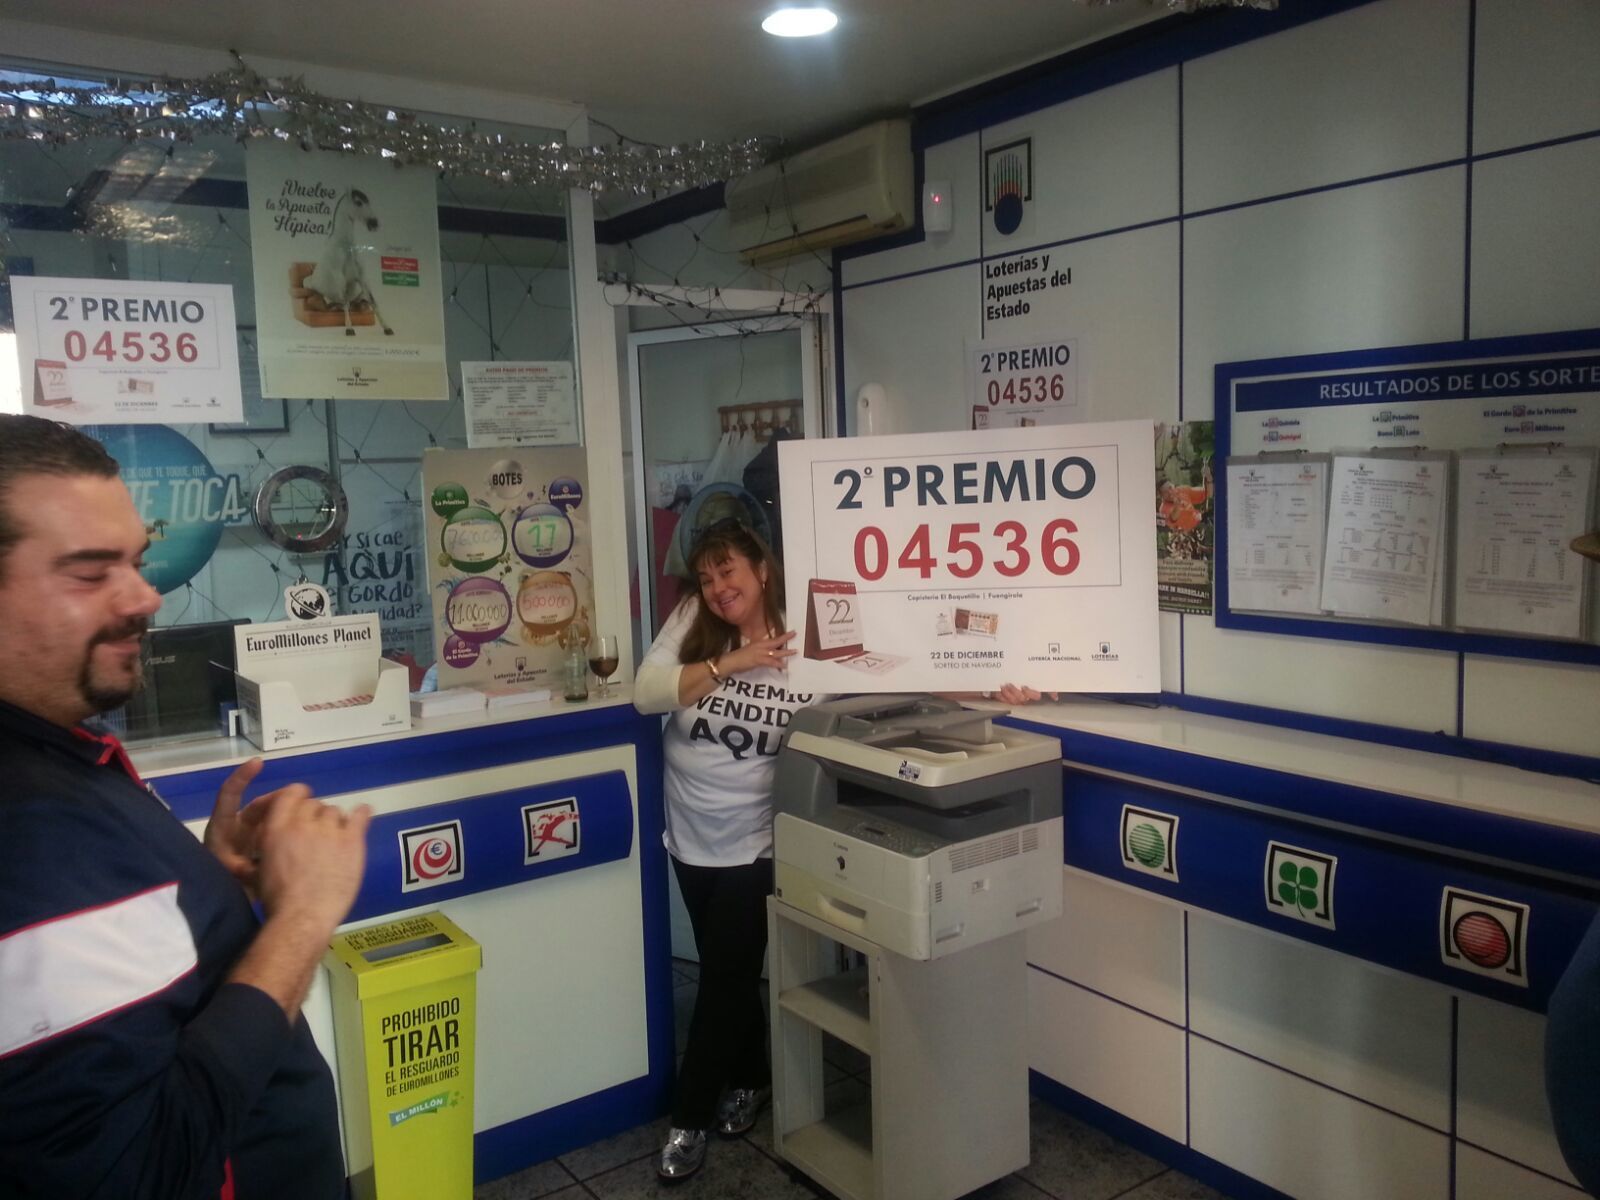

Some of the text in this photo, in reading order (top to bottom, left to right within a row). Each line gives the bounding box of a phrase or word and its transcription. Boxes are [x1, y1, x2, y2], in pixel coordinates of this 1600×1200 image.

[281, 179, 336, 199] ¡Vuelve
[278, 198, 331, 218] Apuesta
[274, 215, 332, 238] Hípica!
[986, 254, 1050, 279] Loterías y
[987, 267, 1072, 302] Apuestas del
[81, 297, 205, 323] PREMIO
[986, 299, 1030, 320] Estado
[64, 330, 199, 363] 04536
[997, 344, 1070, 372] PREMIO
[987, 373, 1064, 406] 04536
[1320, 376, 1441, 400] RESULTADOS
[1448, 374, 1474, 391] DE
[1481, 371, 1521, 389] LOS
[492, 472, 523, 486] BOTES
[882, 456, 1096, 508] PREMIO
[125, 476, 247, 527] TE TOCA
[527, 524, 556, 548] 17
[853, 518, 1081, 582] 04536
[322, 545, 414, 586] AQUÍ
[988, 592, 1023, 600] Fuengirola
[826, 598, 854, 625] 22
[246, 630, 329, 652] EuroMillones
[333, 626, 372, 649] Planet
[145, 655, 176, 666] ASUS
[943, 651, 955, 659] DE
[957, 650, 1004, 659] DICIEMBRE
[364, 920, 434, 943] RESGUARDO
[401, 917, 429, 930] TIRAR
[381, 997, 460, 1035] PROHIBIDO
[382, 1019, 460, 1068] TIRAR
[385, 1050, 460, 1085] EL RESGUARDO
[386, 1066, 460, 1097] DE EUROMILLONES
[395, 1112, 407, 1122] EL
